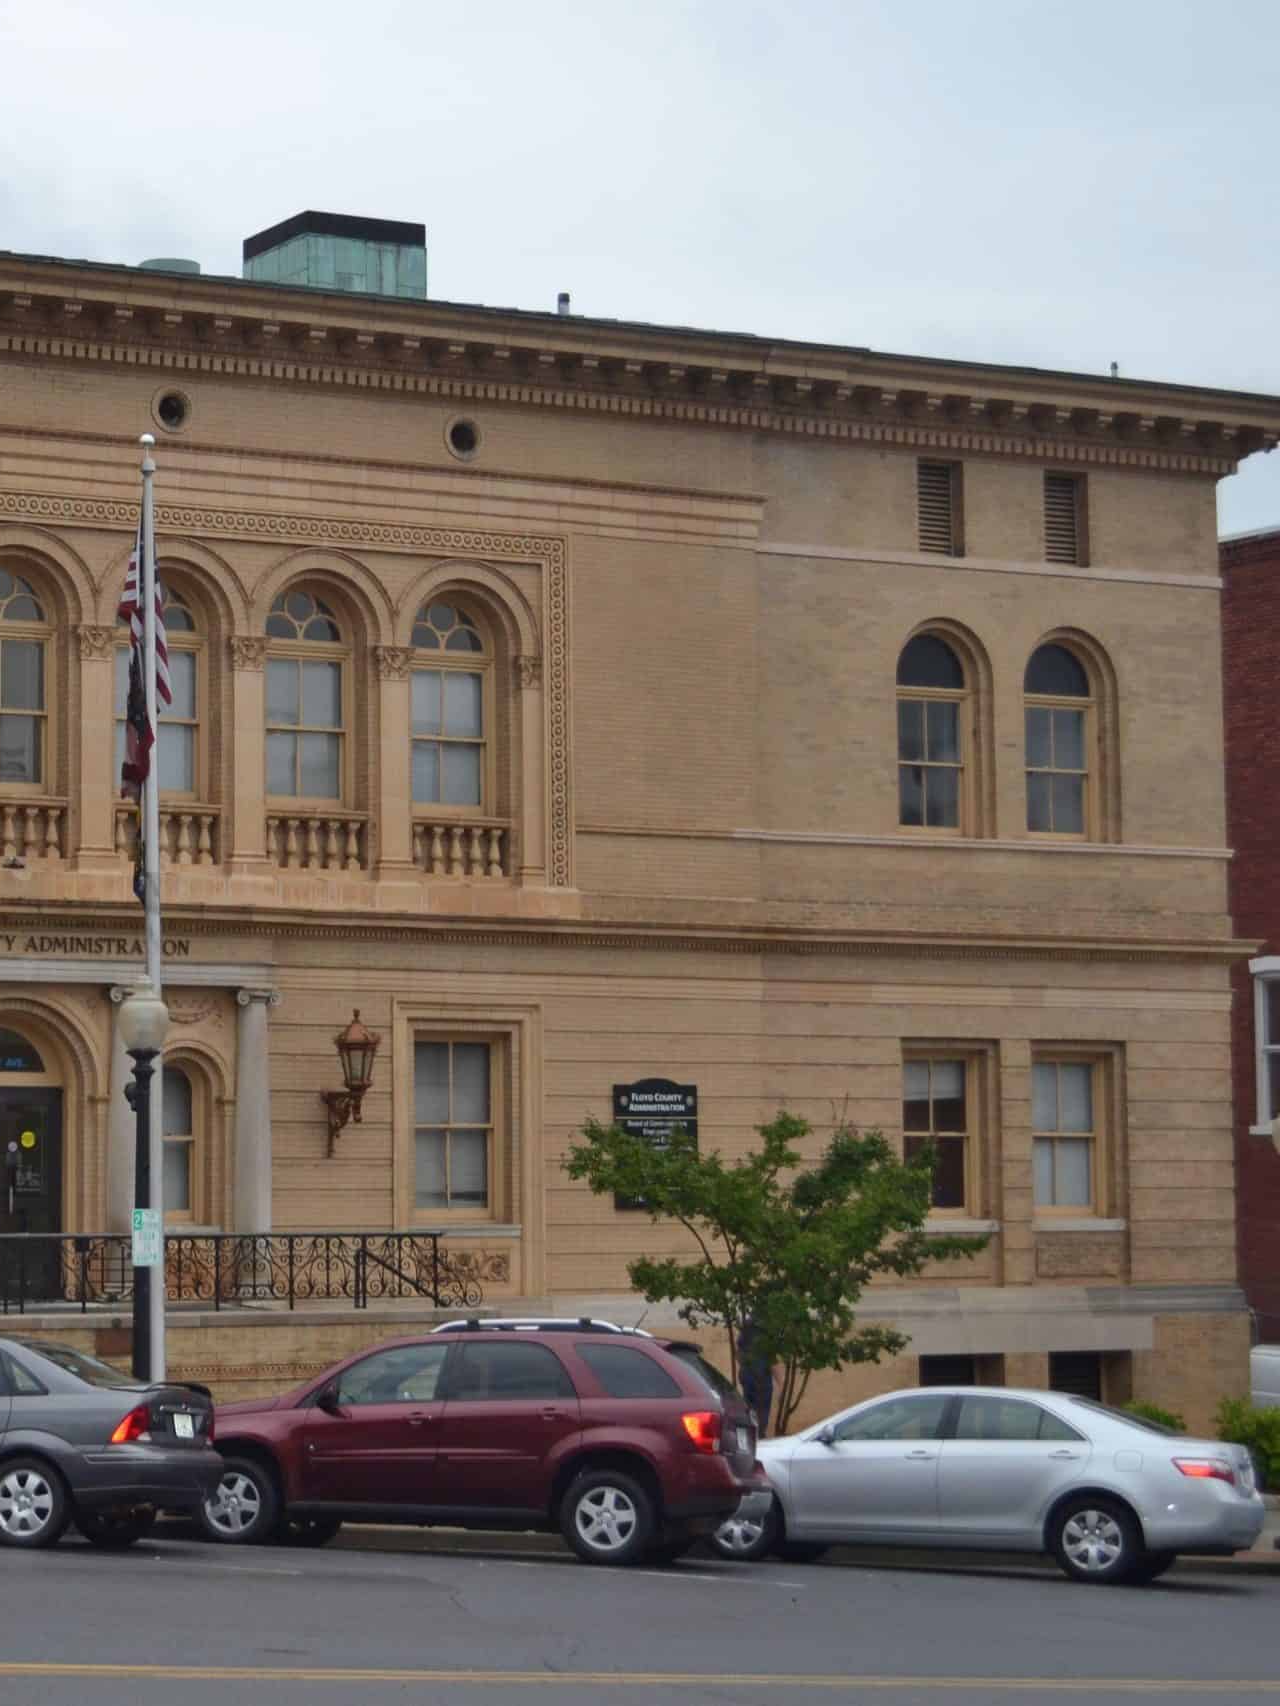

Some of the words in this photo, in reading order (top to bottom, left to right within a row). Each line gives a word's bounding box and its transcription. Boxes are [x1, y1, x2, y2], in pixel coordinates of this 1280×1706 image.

[24, 935, 191, 957] ADMINISTRAON
[631, 1092, 653, 1102] FLOYD
[654, 1092, 683, 1102] COUNTY
[134, 1214, 142, 1228] 2
